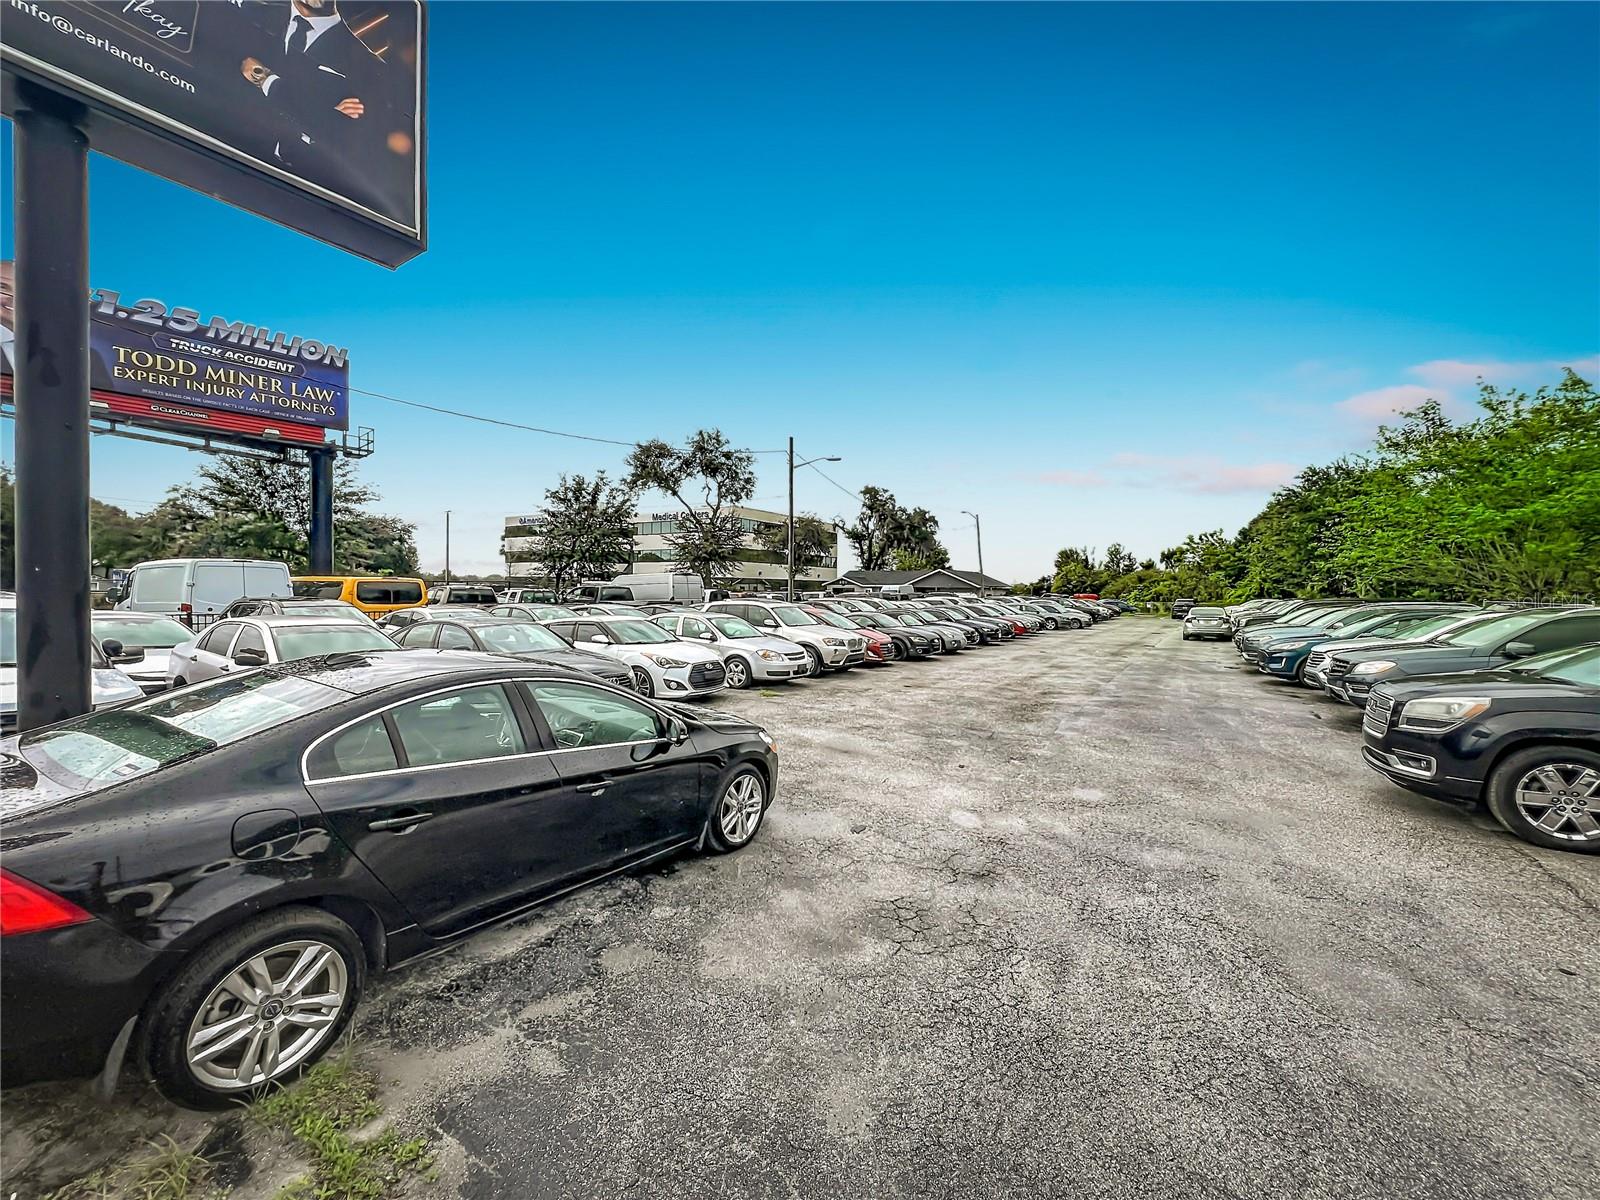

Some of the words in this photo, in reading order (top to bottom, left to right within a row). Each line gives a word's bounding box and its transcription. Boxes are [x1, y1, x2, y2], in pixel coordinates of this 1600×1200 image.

[89, 288, 199, 332] 1.25
[206, 316, 349, 368] MILLION
[112, 346, 198, 376] TODD
[205, 365, 286, 395] MINER
[290, 382, 335, 403] LAW
[170, 338, 223, 357] TRUCK
[224, 350, 295, 373] ACCIDENT
[113, 366, 181, 387] EXPERT
[186, 380, 246, 399] INJURY
[249, 392, 336, 416] ATTORNEYS
[652, 511, 679, 521] Medical
[680, 511, 709, 519] Ceters
